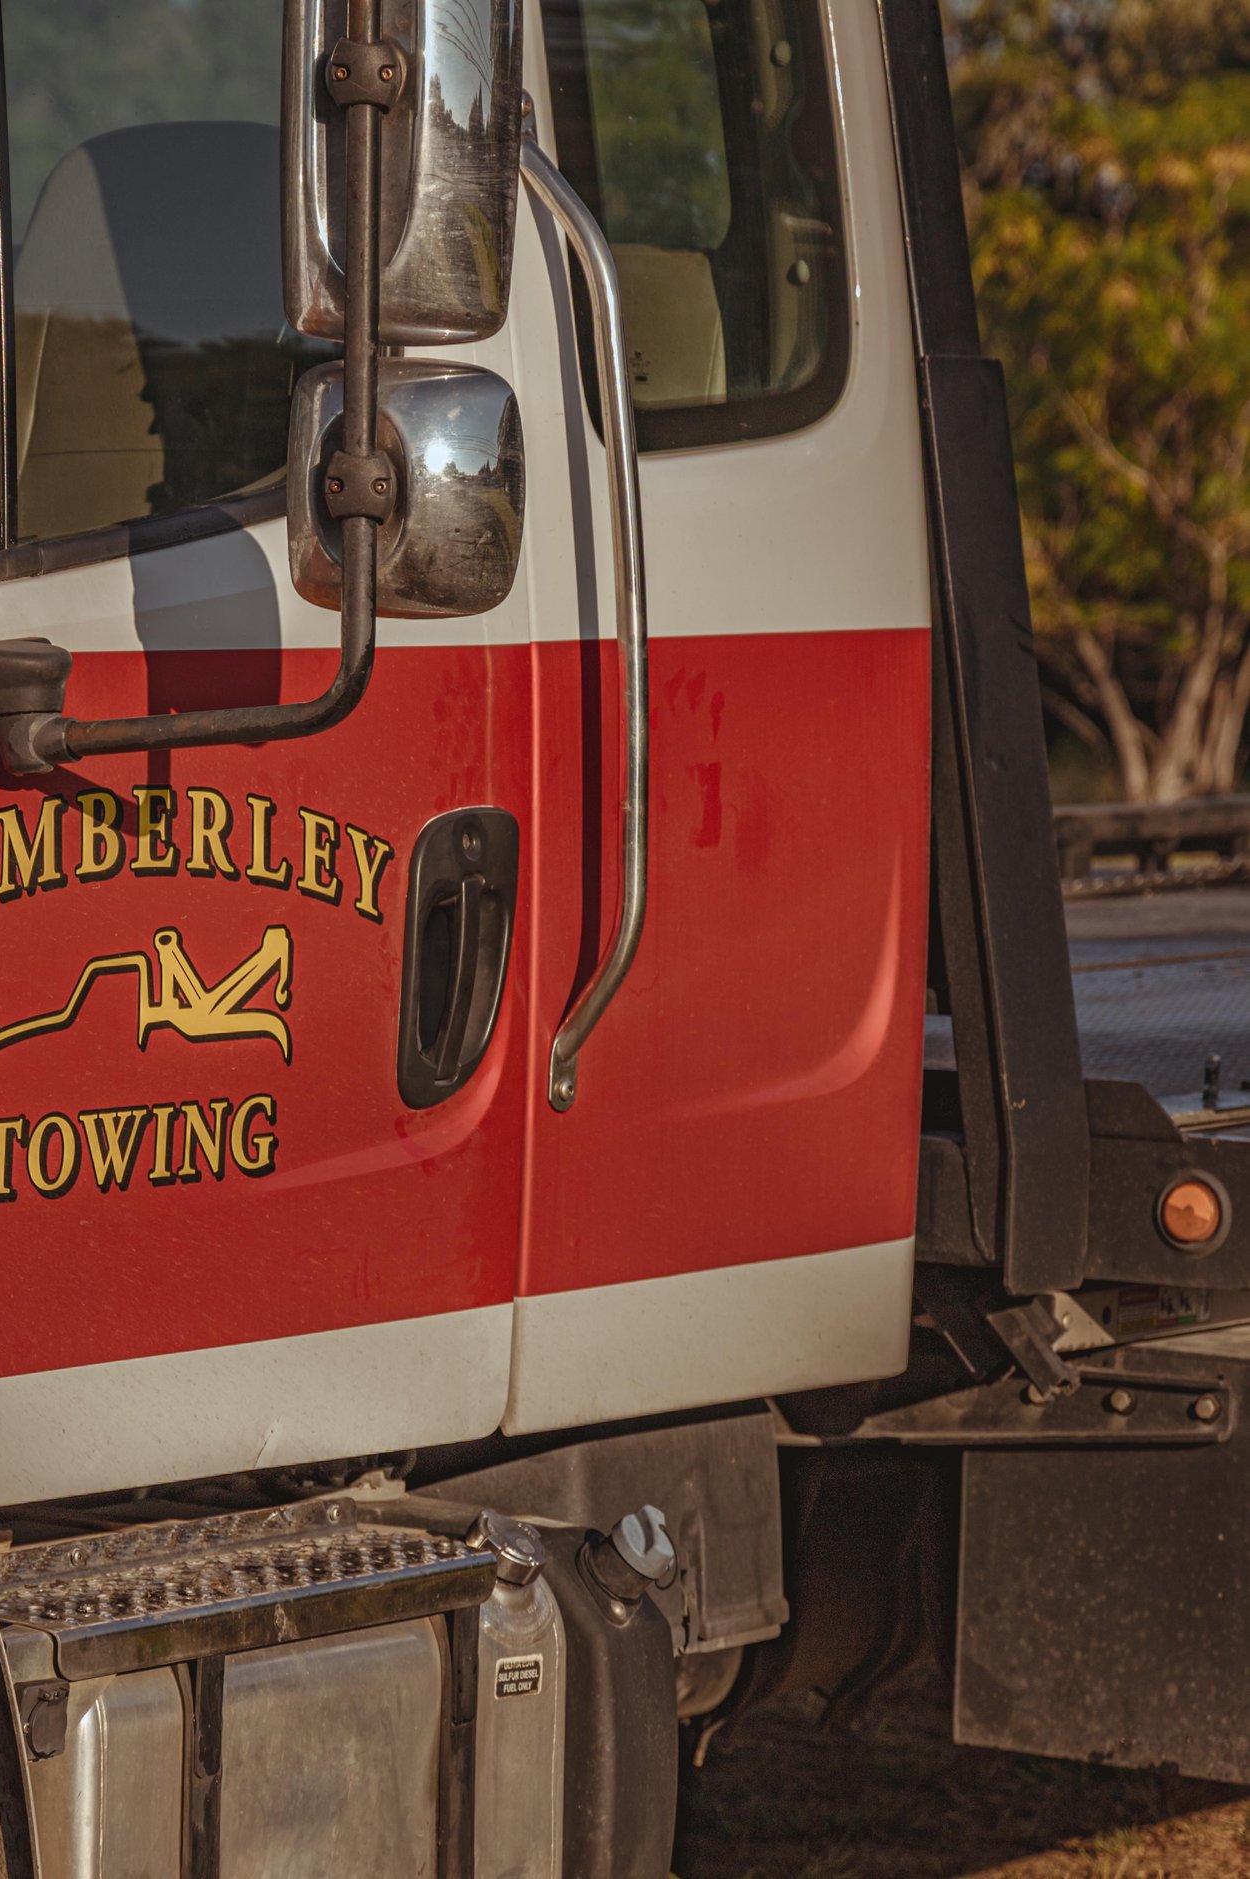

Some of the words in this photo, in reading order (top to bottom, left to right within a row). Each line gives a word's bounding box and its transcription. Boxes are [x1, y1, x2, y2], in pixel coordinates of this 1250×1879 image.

[498, 1671, 519, 1682] SULFUR
[519, 1669, 538, 1680] DIESEL
[503, 1682, 517, 1694] FUEL
[517, 1681, 532, 1691] ONLY
